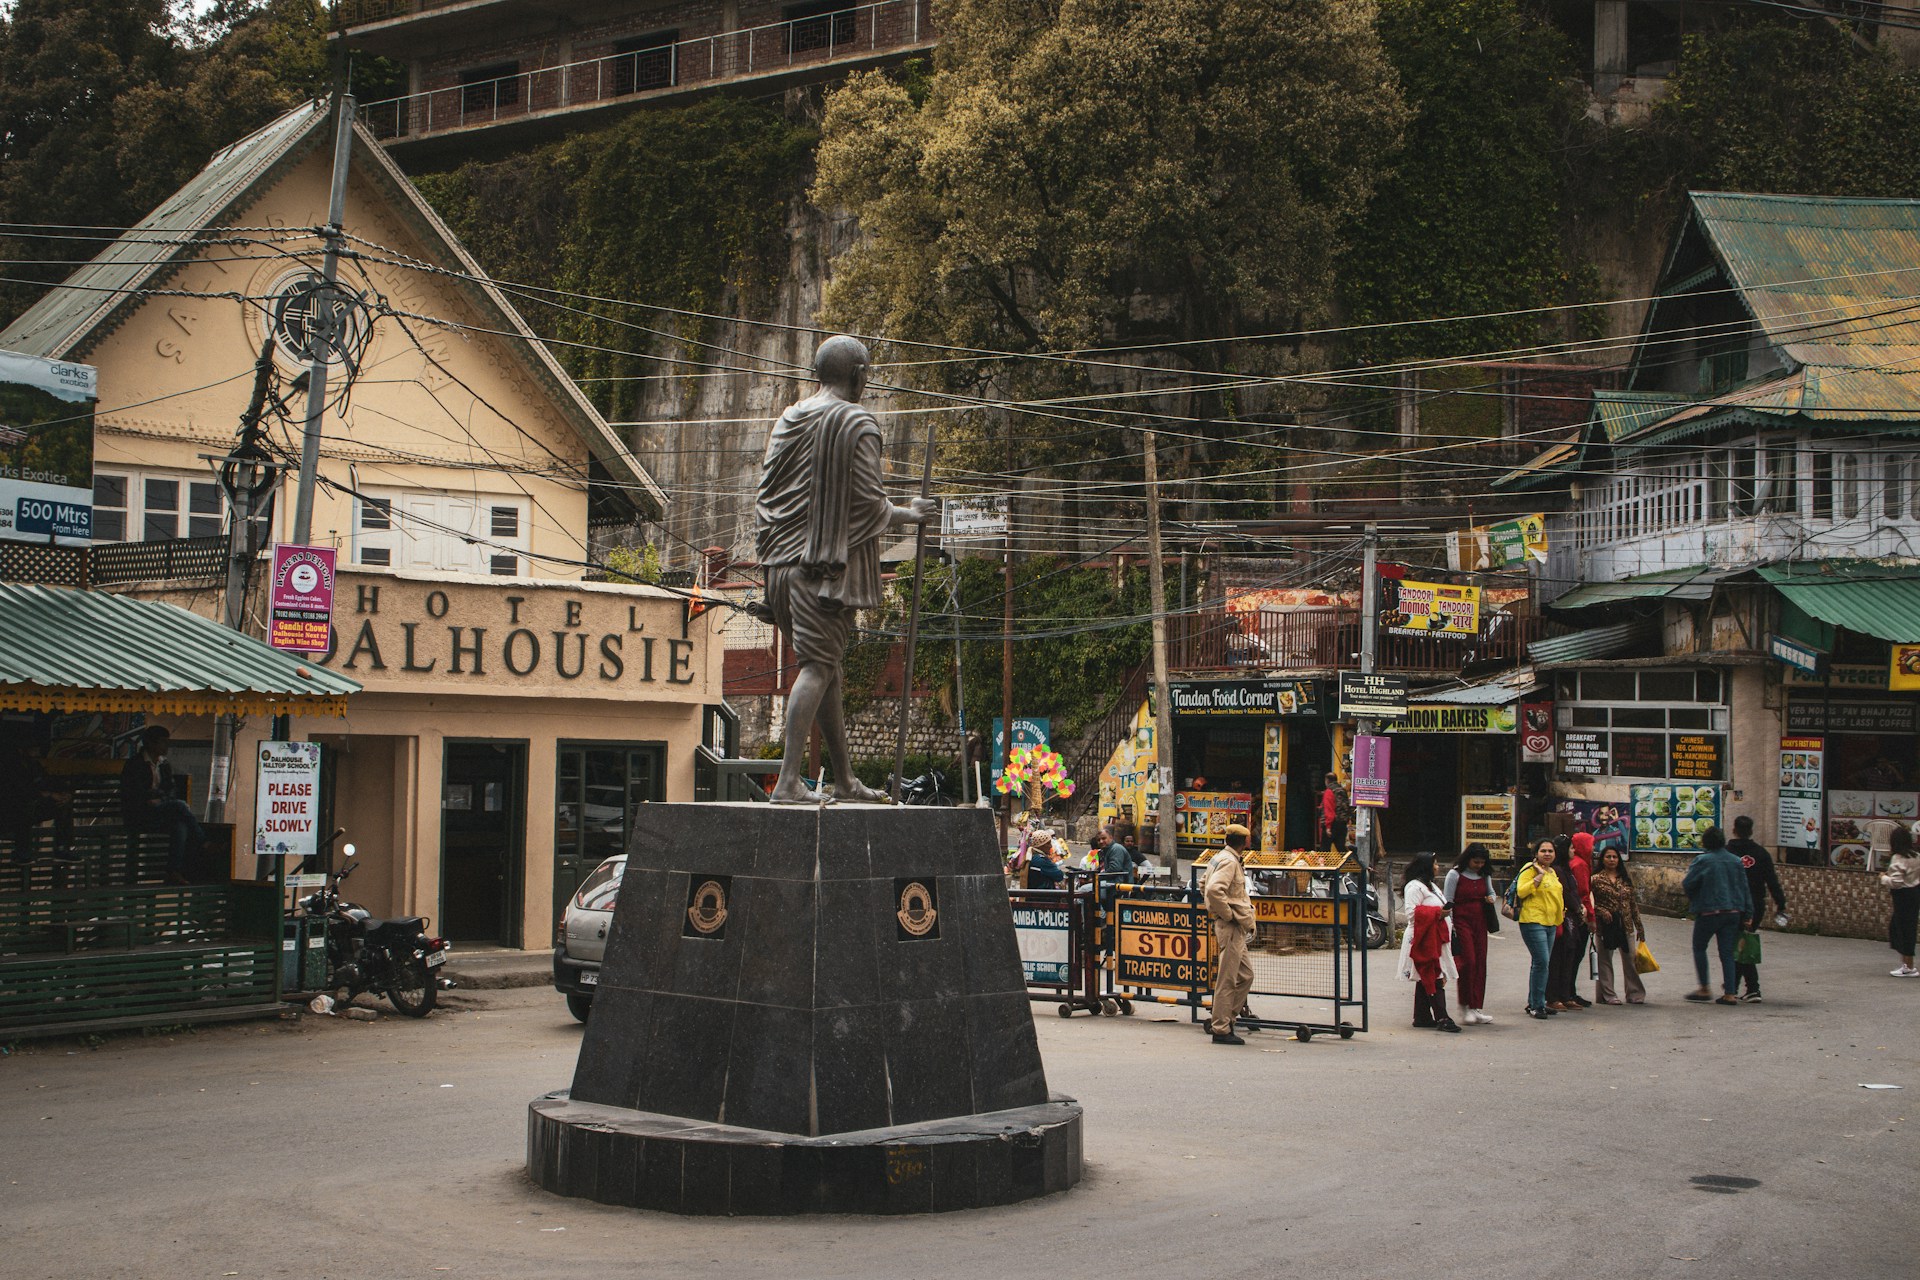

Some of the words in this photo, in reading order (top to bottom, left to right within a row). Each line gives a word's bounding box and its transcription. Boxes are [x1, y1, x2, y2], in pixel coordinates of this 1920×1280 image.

[50, 364, 89, 380] clarks
[60, 379, 89, 388] exotica
[22, 467, 67, 484] Exotica
[21, 501, 53, 520] 500
[56, 505, 89, 525] Mtrs
[52, 523, 71, 534] From
[72, 526, 90, 536] Here
[276, 552, 304, 587] BAKERS
[305, 552, 331, 590] DELIGHT
[1398, 587, 1434, 601] TANDOORI
[357, 585, 644, 632] HOTEL
[1438, 601, 1474, 614] TANDOORI
[279, 622, 304, 631] Gandhi
[305, 623, 328, 633] Chowk
[1452, 615, 1474, 629] चाय
[273, 630, 304, 638] Dalhousie
[1389, 627, 1428, 636] BREAKFAST
[1432, 631, 1467, 640] FASTFOOD
[274, 637, 296, 646] English
[311, 639, 325, 648] Shop
[1364, 676, 1385, 686] HH
[1344, 684, 1367, 694] HOTEL
[1369, 686, 1405, 695] HIGHLAND
[1172, 688, 1211, 706] Tandon
[1212, 688, 1238, 706] Food
[1239, 688, 1274, 706] Corner
[1441, 709, 1489, 728] BAKERS
[1889, 708, 1912, 716] PIZZA
[1790, 717, 1810, 726] CHAT
[1850, 719, 1874, 727] LASSI
[1880, 719, 1912, 728] COFFEE
[1022, 720, 1046, 744] STATION
[1565, 734, 1597, 742] BREAKFAST
[1567, 758, 1599, 766] SANDWICHES
[1678, 760, 1694, 768] FRIED
[1565, 766, 1584, 774] BUTTER
[1118, 771, 1145, 789] TFC
[1355, 778, 1387, 786] DELIGHT
[268, 783, 312, 796] PLEASE
[272, 801, 307, 814] DRIVE
[265, 819, 312, 832] SLOWLY
[1283, 903, 1328, 919] POLICE
[1013, 910, 1036, 926] AMBA
[1038, 911, 1069, 927] POLICE
[1132, 910, 1171, 926] CHAMBA
[1173, 913, 1207, 929] POLCE
[1036, 963, 1057, 972] SCHOOL
[1125, 960, 1171, 978] TRAFFIC
